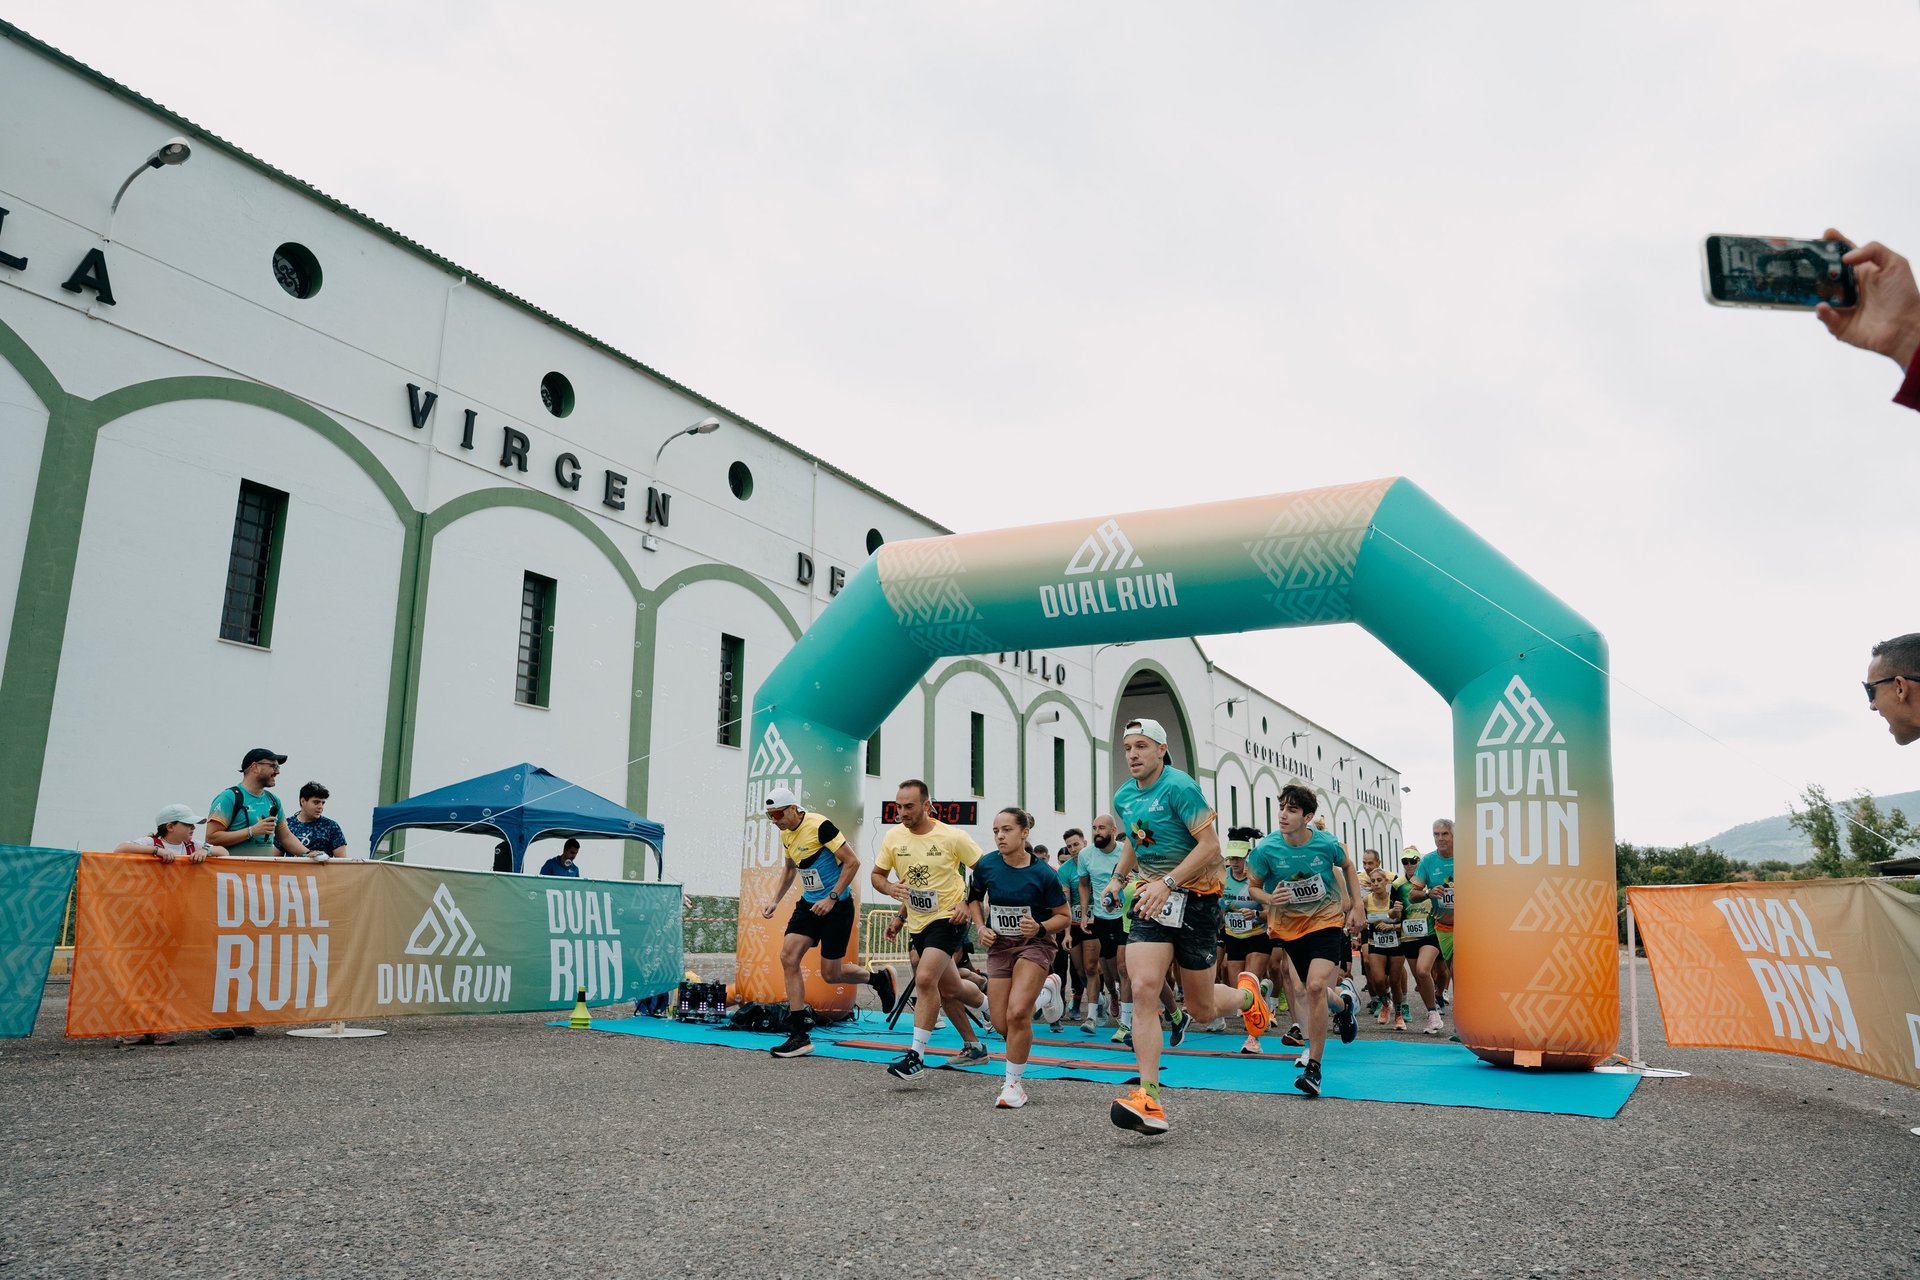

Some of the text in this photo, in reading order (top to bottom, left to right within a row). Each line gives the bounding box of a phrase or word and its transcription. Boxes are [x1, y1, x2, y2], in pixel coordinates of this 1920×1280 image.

[406, 382, 672, 528] VIRGEN
[1039, 572, 1178, 618] DUAL RUN
[1475, 749, 1578, 798] DUAL
[744, 818, 786, 868] RU
[1476, 800, 1580, 867] RUN
[216, 872, 330, 928] DUAL
[545, 889, 621, 935] DUAL
[909, 894, 932, 909] 1080
[1292, 883, 1319, 897] 1006
[1229, 918, 1246, 929] 1081
[1377, 935, 1394, 944] 1079
[1406, 923, 1424, 933] 1065
[1712, 896, 1833, 960] DUAL
[211, 934, 330, 1013] RUN
[377, 963, 512, 1005] DUAL RUN
[549, 938, 624, 1002] RUN
[1746, 958, 1864, 1055] RUN
